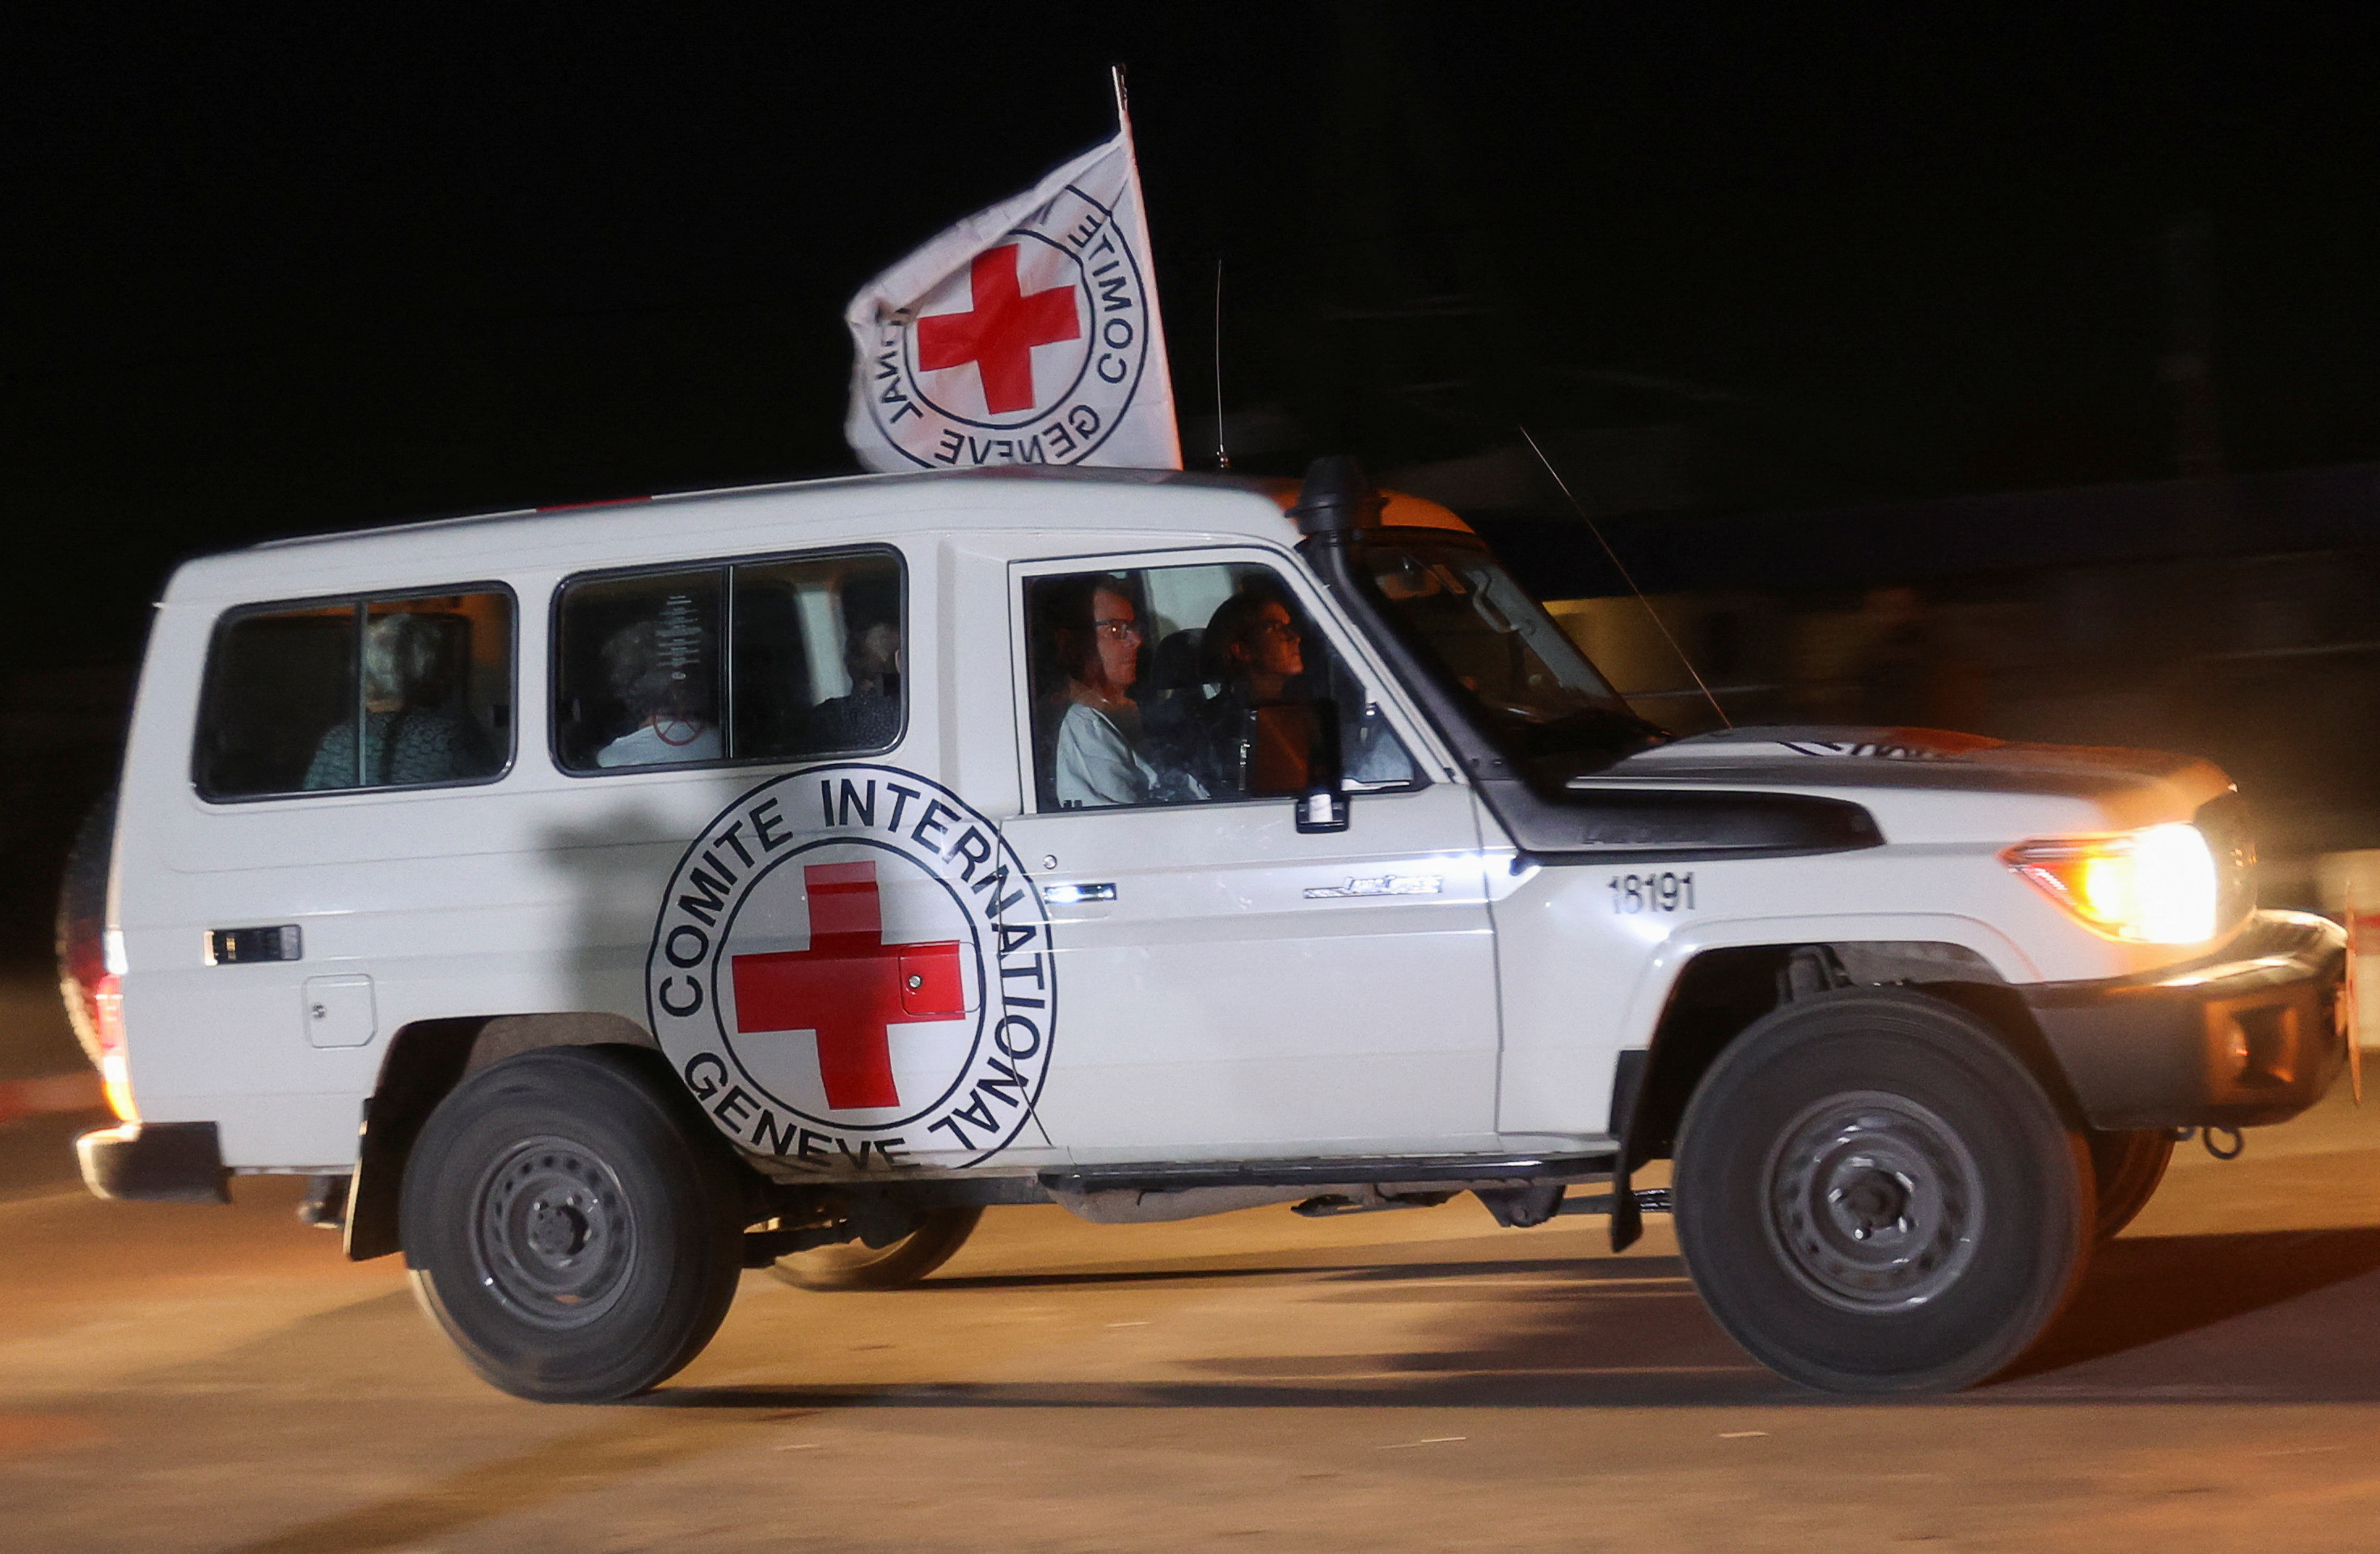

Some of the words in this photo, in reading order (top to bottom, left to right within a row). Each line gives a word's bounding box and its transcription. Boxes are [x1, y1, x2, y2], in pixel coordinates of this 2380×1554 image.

[1608, 872, 1696, 914] 18191
[659, 797, 793, 1017] COMITE
[821, 779, 1046, 1150] INTERNATIONAL
[685, 1052, 921, 1170] GENEVE
